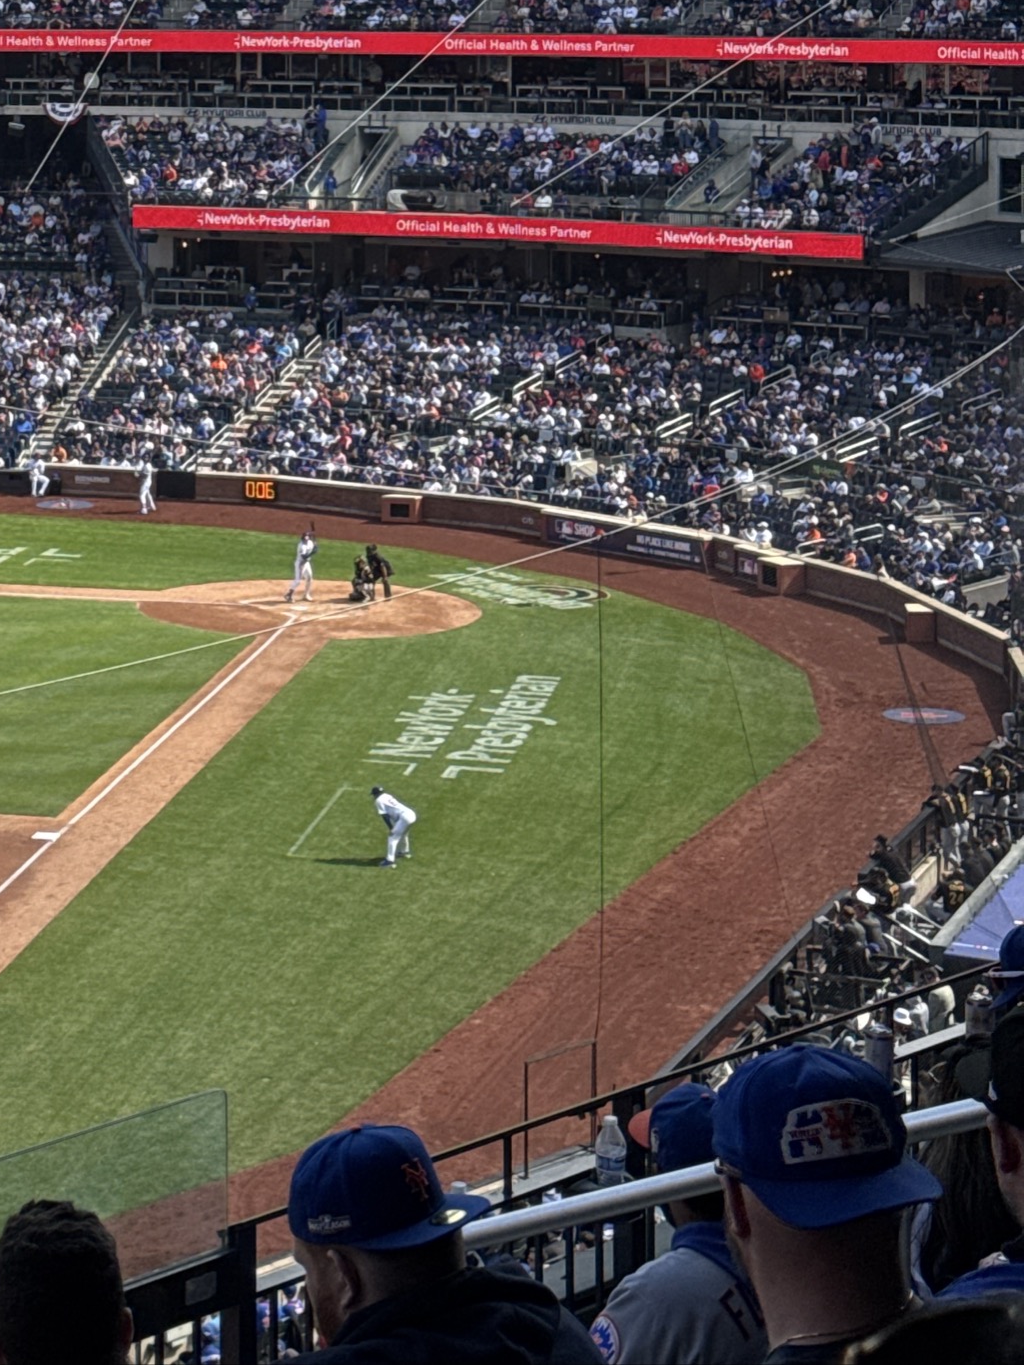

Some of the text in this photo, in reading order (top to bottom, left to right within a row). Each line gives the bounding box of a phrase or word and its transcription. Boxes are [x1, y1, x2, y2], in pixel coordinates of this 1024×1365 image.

[6, 35, 43, 46] Health
[46, 36, 55, 47] &
[57, 36, 107, 47] Wellness
[110, 36, 152, 48] Partner
[241, 35, 362, 51] NewYork-Presbyterian
[445, 39, 635, 53] Official Health & Wellness Partner
[724, 41, 849, 59] NewYork-Presbyterian
[937, 46, 980, 59] Official
[983, 47, 1019, 61] Health
[205, 212, 331, 231] NewYork-Presbyterian
[396, 219, 592, 240] Official Health & Wellness Partner
[663, 230, 793, 252] NewYork-Presbyterian
[368, 687, 476, 759] NewYork-
[446, 674, 562, 763] Presbyterian
